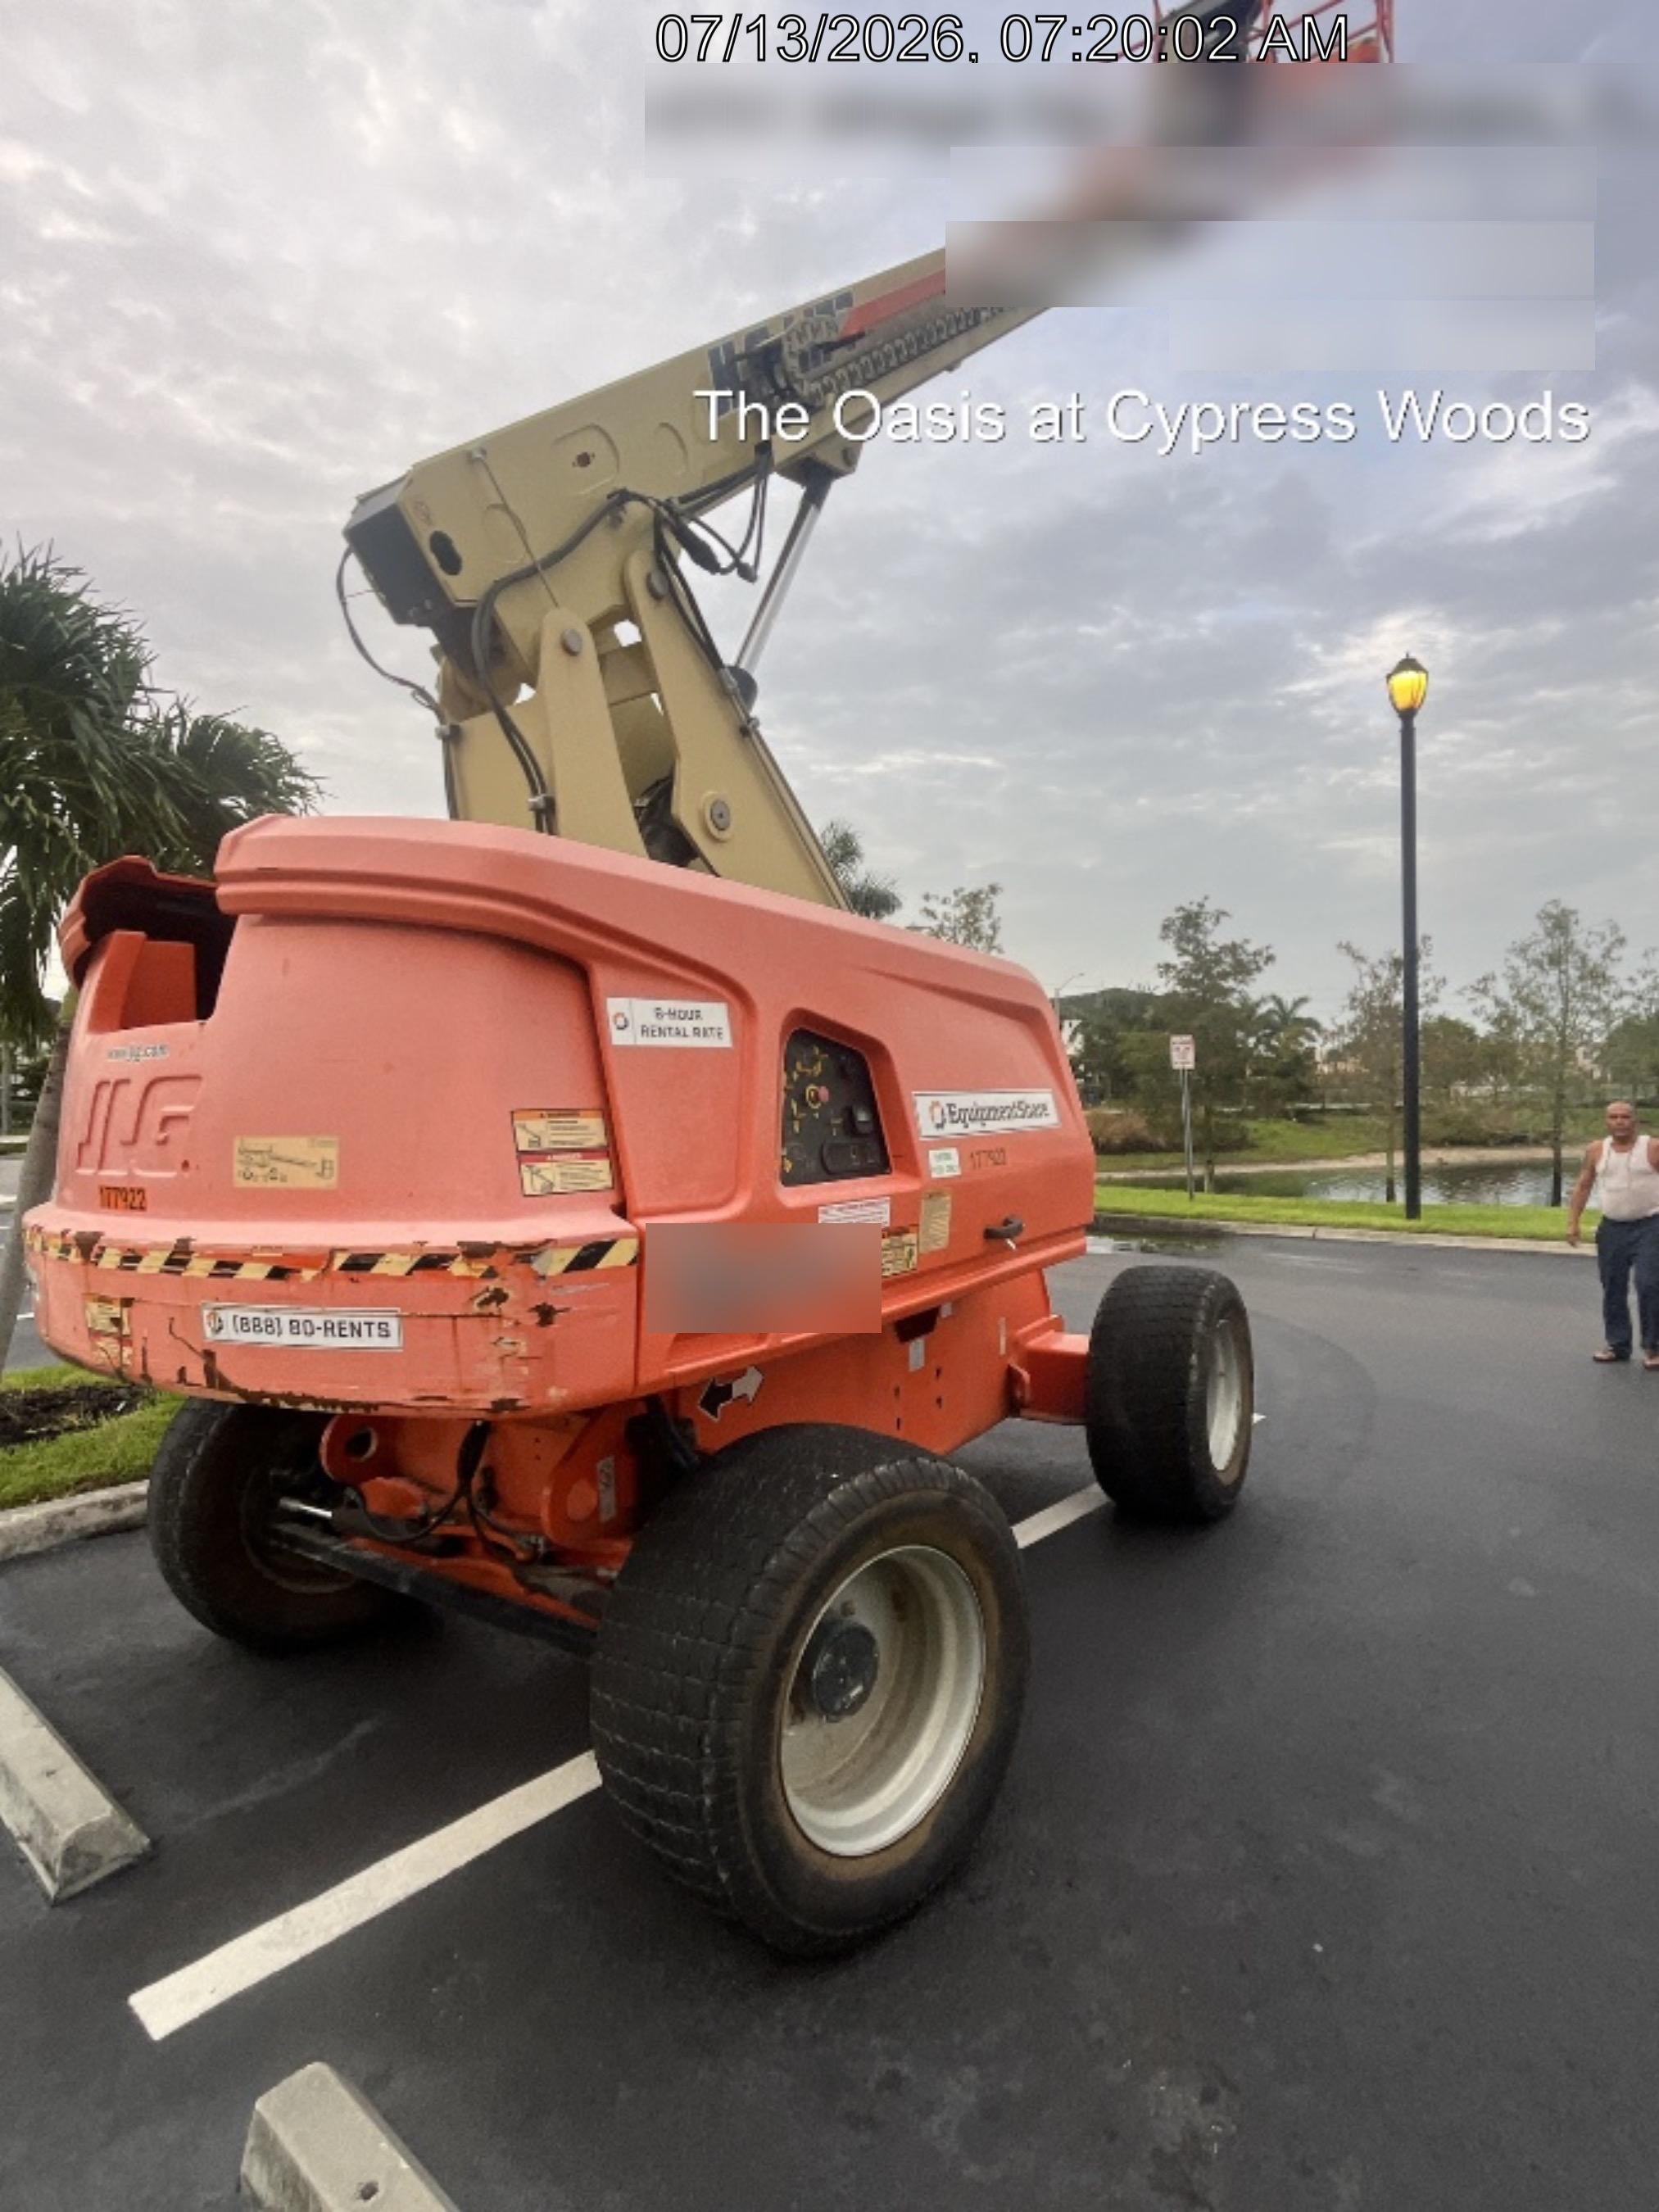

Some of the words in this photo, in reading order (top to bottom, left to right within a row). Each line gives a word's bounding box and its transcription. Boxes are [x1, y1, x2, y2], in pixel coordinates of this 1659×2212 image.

[641, 1024, 689, 1038] RENTAL
[692, 1027, 723, 1040] RATE
[232, 1313, 283, 1337] (888)
[288, 1318, 392, 1339] 80-RENTS
